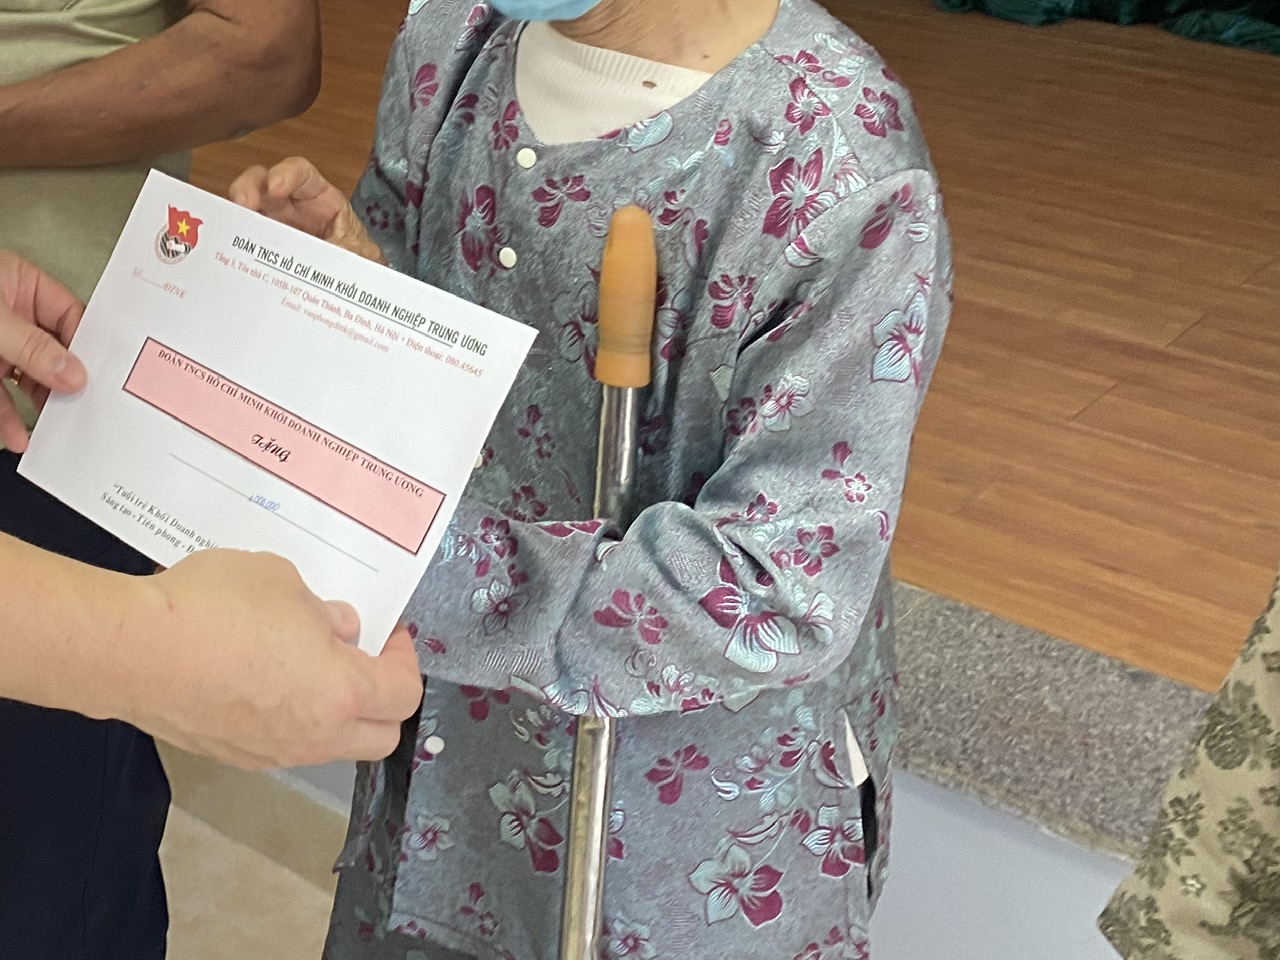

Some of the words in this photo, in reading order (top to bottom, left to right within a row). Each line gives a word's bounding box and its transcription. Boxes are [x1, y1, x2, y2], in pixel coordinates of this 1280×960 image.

[232, 235, 257, 254] ĐOÀN
[257, 246, 280, 265] TNCS
[279, 256, 294, 271] HỒ
[294, 263, 312, 278] CHÍ
[310, 270, 335, 289] MINH
[334, 280, 358, 300] KHỐI
[358, 290, 391, 314] DOANH
[391, 305, 426, 329] NGHIỆP
[427, 320, 460, 344] TRUNG
[460, 334, 488, 356] ƯƠNG
[374, 324, 385, 334] Hà
[158, 349, 183, 367] ĐOÀN
[184, 362, 206, 380] TNCS
[205, 374, 220, 388] HỒ
[220, 383, 239, 397] CHÍ
[238, 392, 264, 411] MINH
[263, 406, 288, 425] KHỐI
[287, 419, 321, 442] DOANH
[321, 437, 359, 462] NGHIỆP
[360, 457, 394, 481] TRUNG
[394, 475, 424, 497] ƯƠNG
[154, 528, 181, 548] phong
[169, 518, 195, 538] Doanh
